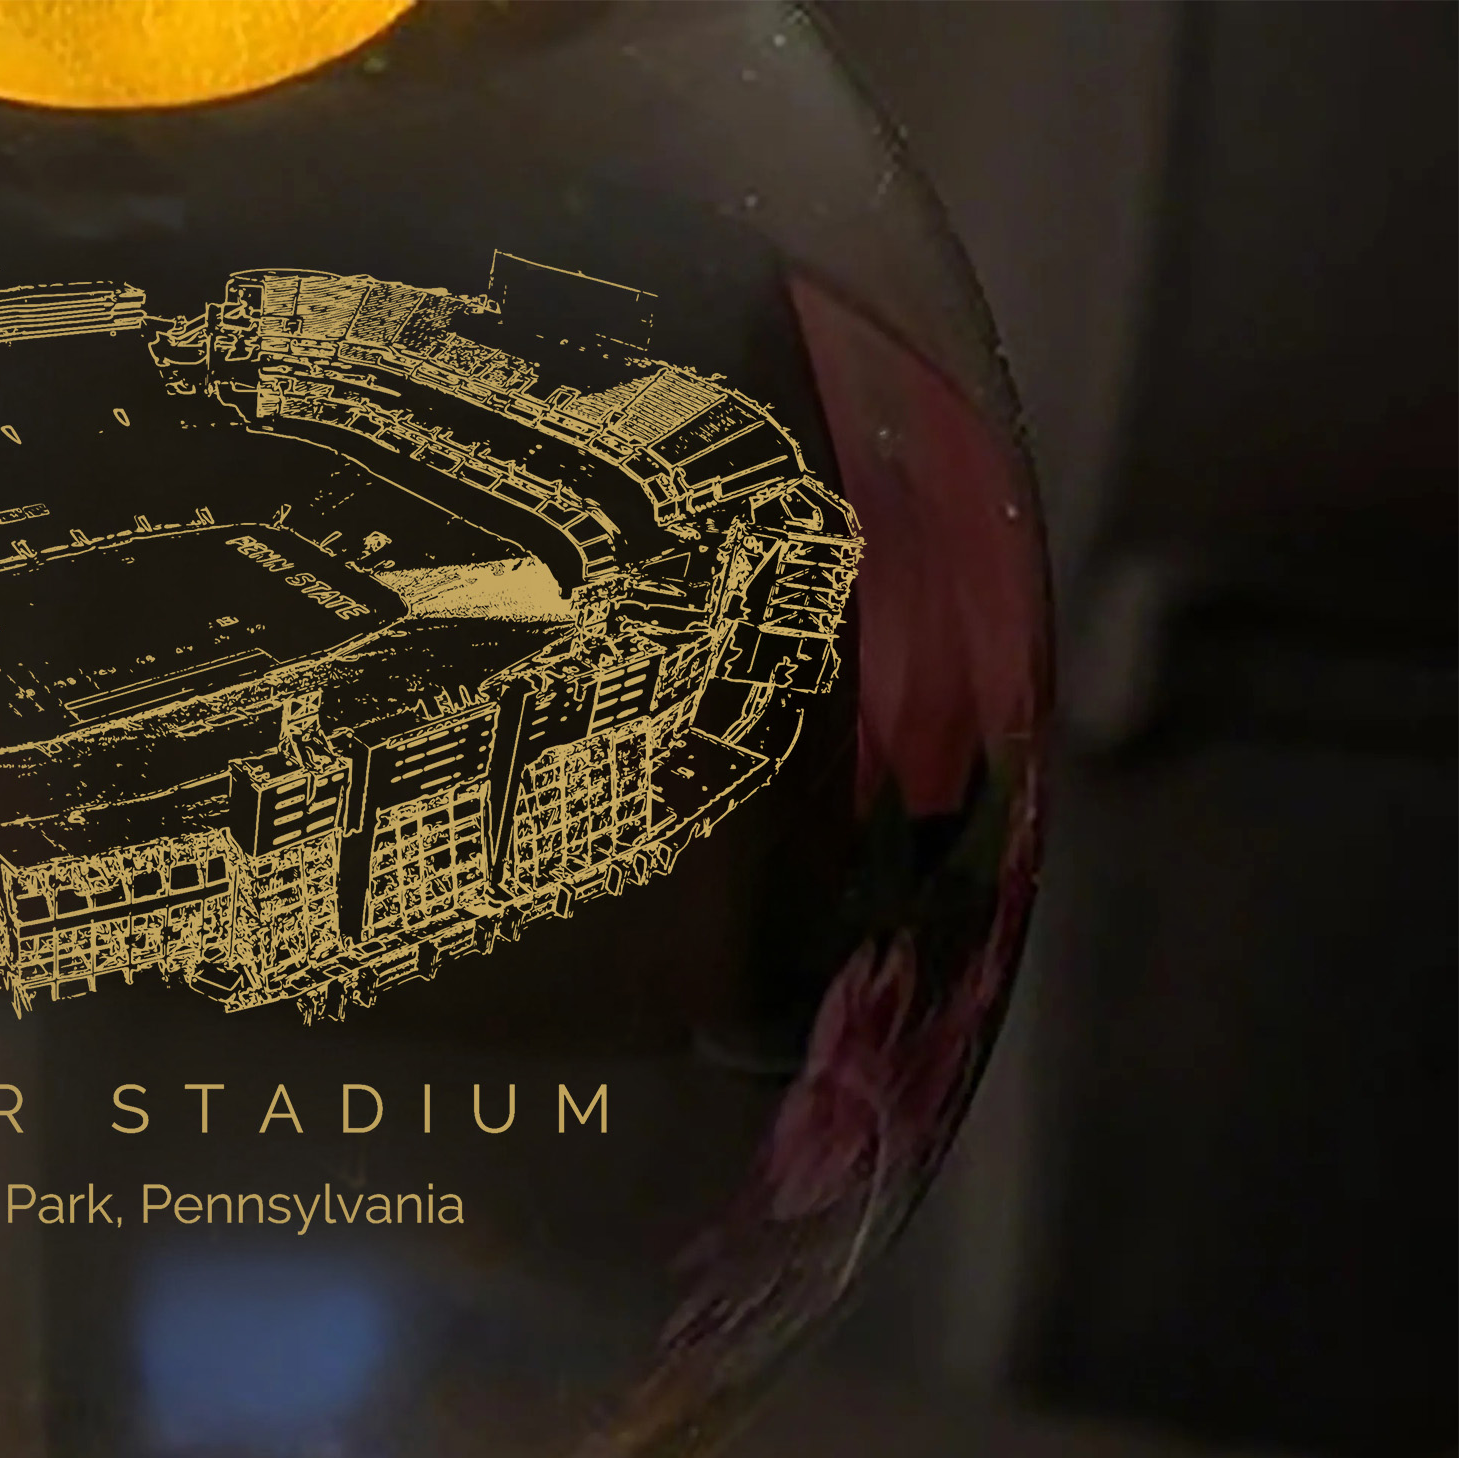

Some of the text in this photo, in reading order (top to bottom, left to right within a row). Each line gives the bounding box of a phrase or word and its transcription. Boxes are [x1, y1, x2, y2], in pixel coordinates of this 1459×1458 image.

[285, 572, 370, 620] STATE
[110, 1083, 611, 1135] STADIUM
[6, 1182, 124, 1228] Park,
[142, 1182, 466, 1236] Pennsylvania
